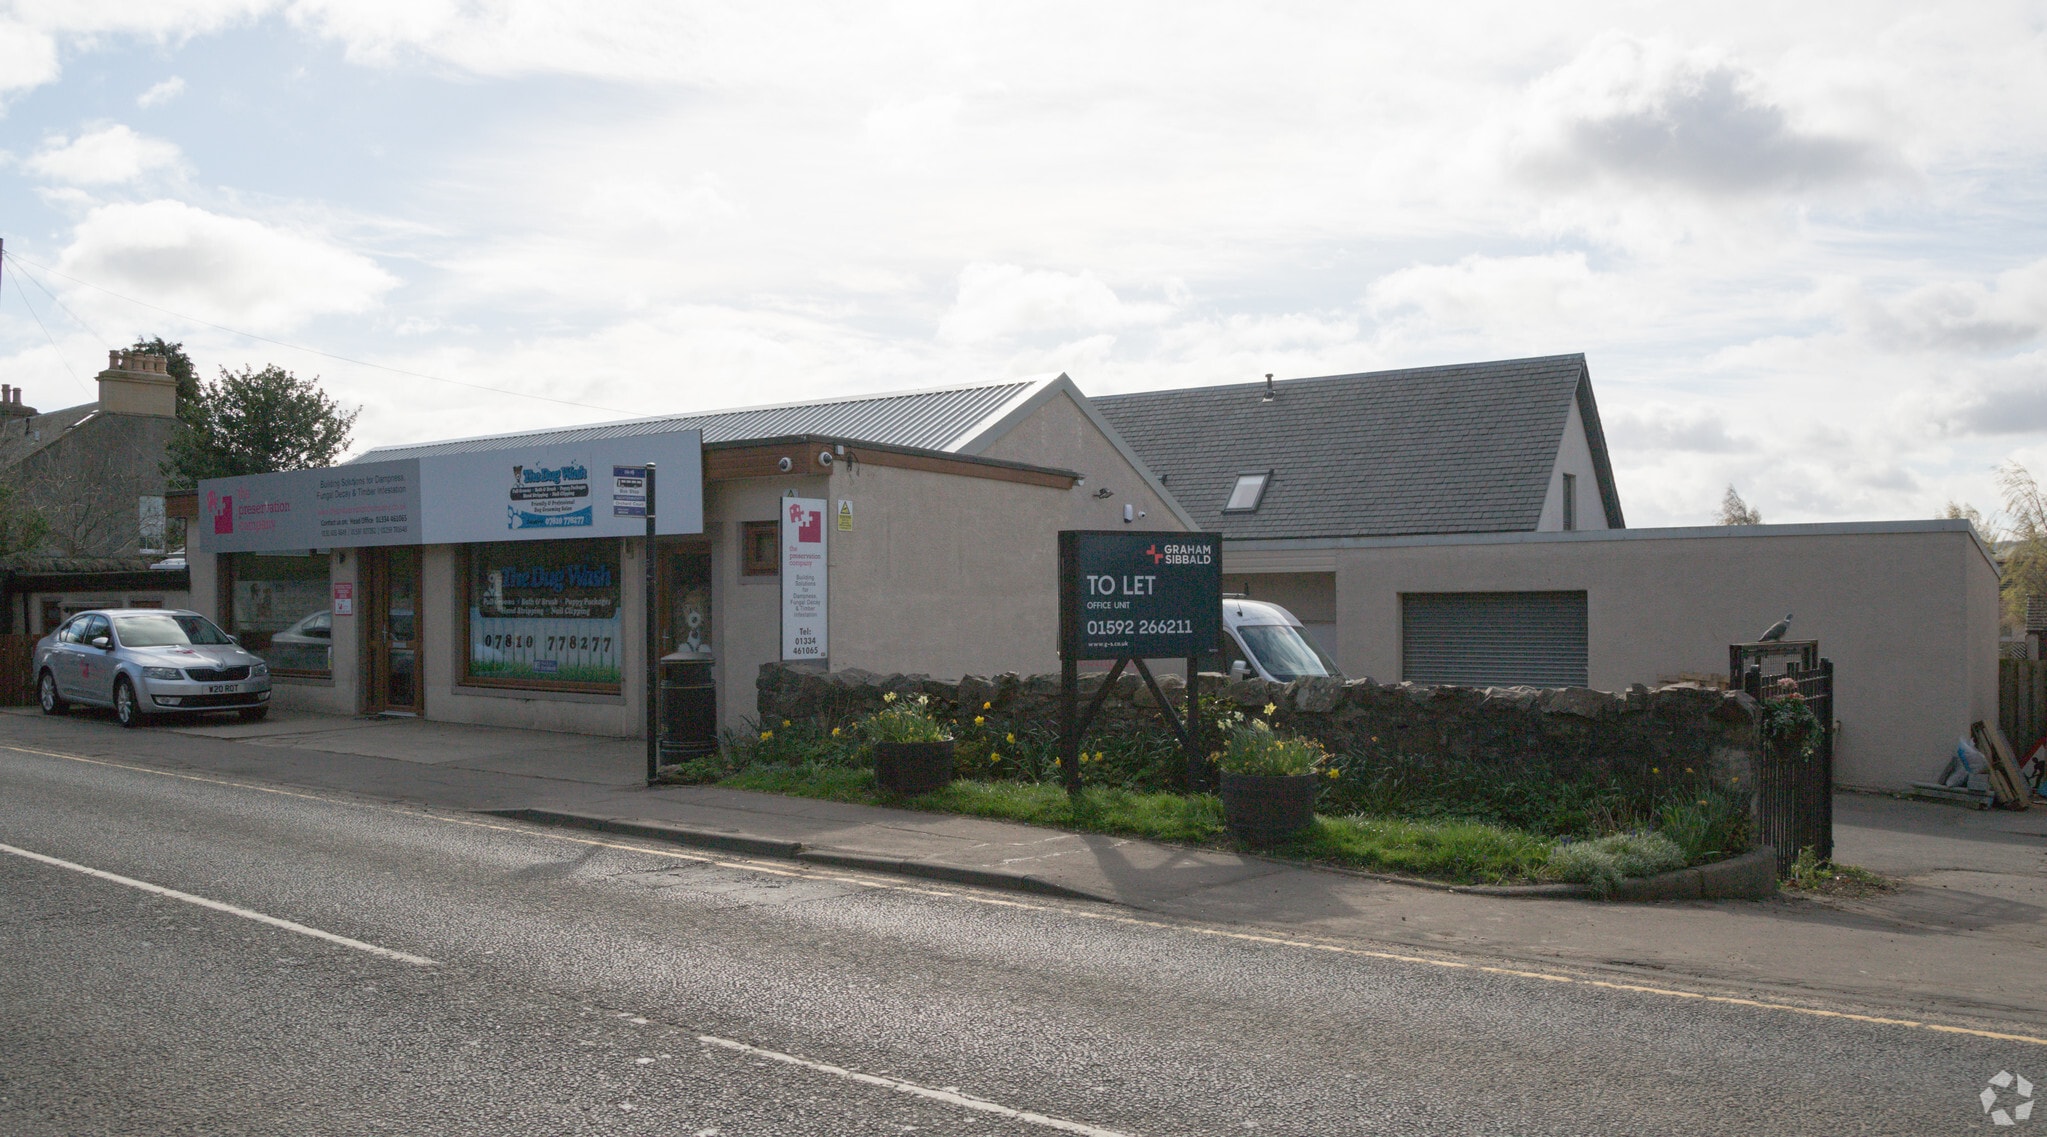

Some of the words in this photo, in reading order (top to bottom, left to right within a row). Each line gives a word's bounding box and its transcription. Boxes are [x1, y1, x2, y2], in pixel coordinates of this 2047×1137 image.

[523, 469, 541, 483] The
[561, 465, 588, 481] Wash
[238, 502, 291, 517] preservation
[1164, 544, 1211, 555] GRAHAM
[1165, 554, 1211, 564] SIBBALD
[502, 566, 530, 588] The
[566, 564, 612, 588] Wash
[1086, 575, 1116, 595] TO
[1122, 575, 1156, 595] LET
[1087, 620, 1134, 634] 01592
[1139, 620, 1193, 634] 266211
[484, 634, 533, 650] 07810
[547, 635, 612, 652] 778277
